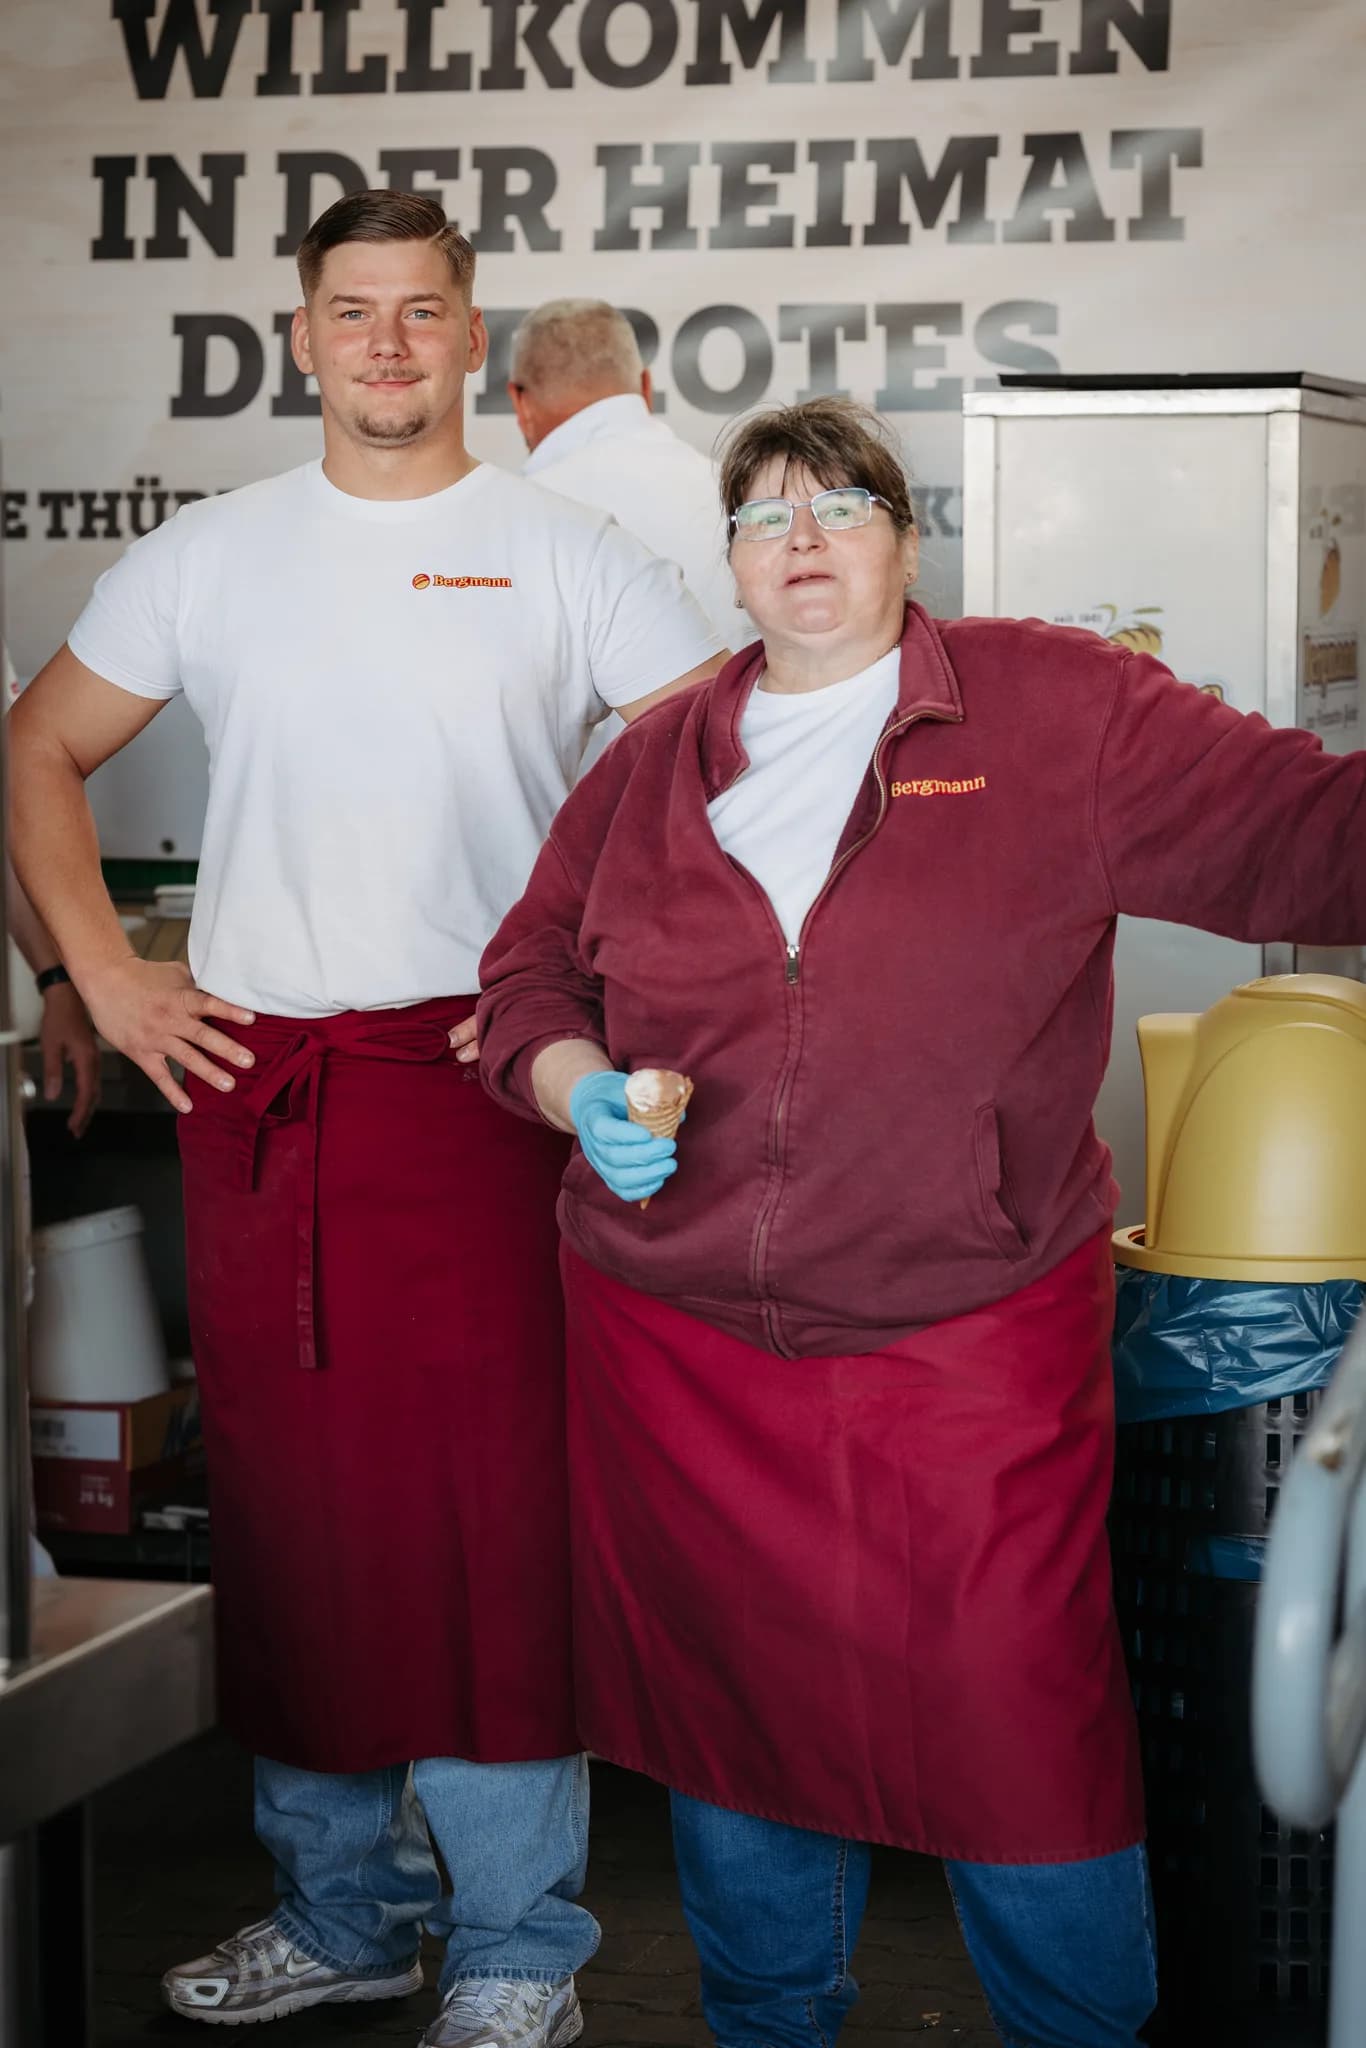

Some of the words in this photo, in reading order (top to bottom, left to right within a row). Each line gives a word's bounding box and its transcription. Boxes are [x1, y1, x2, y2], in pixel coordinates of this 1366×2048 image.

[111, 0, 1170, 100] WILLKOMMEN
[91, 153, 245, 260] IN
[593, 127, 1203, 253] HEIMAT
[475, 300, 1061, 416] OTES
[433, 575, 512, 588] Bergmann
[891, 776, 986, 797] Bergmann
